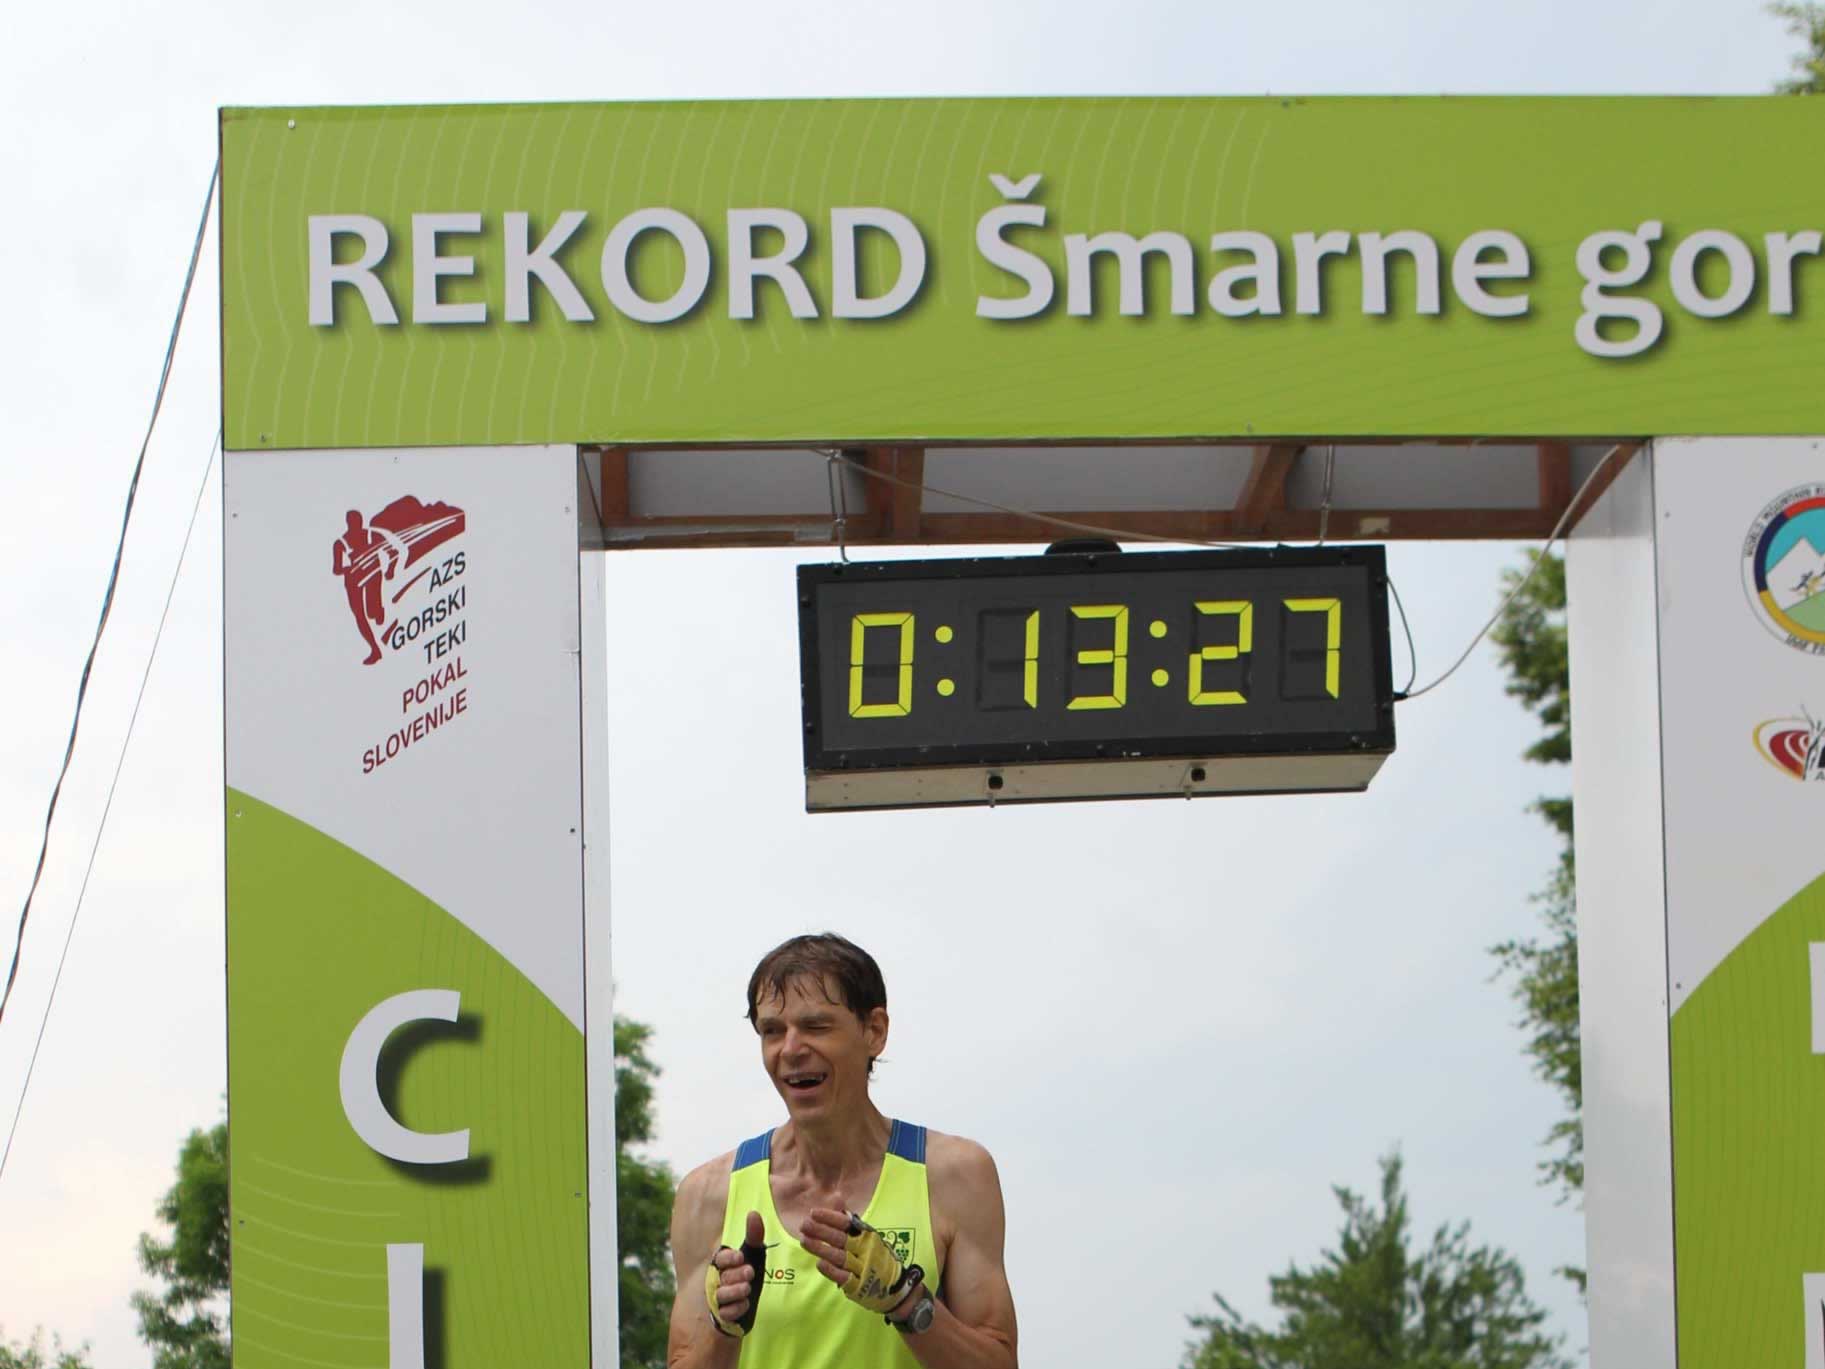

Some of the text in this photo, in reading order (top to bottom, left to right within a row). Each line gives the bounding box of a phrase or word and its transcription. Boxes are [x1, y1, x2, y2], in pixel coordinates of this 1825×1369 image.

[307, 173, 1823, 358] REKORD Šmarne gor
[429, 551, 466, 594] AZS
[391, 585, 466, 650] GORSKI
[423, 620, 466, 664] TEKI
[402, 656, 467, 713] POKAL
[848, 597, 1341, 718] 0:13:27
[362, 688, 467, 774] SLOVENIJE
